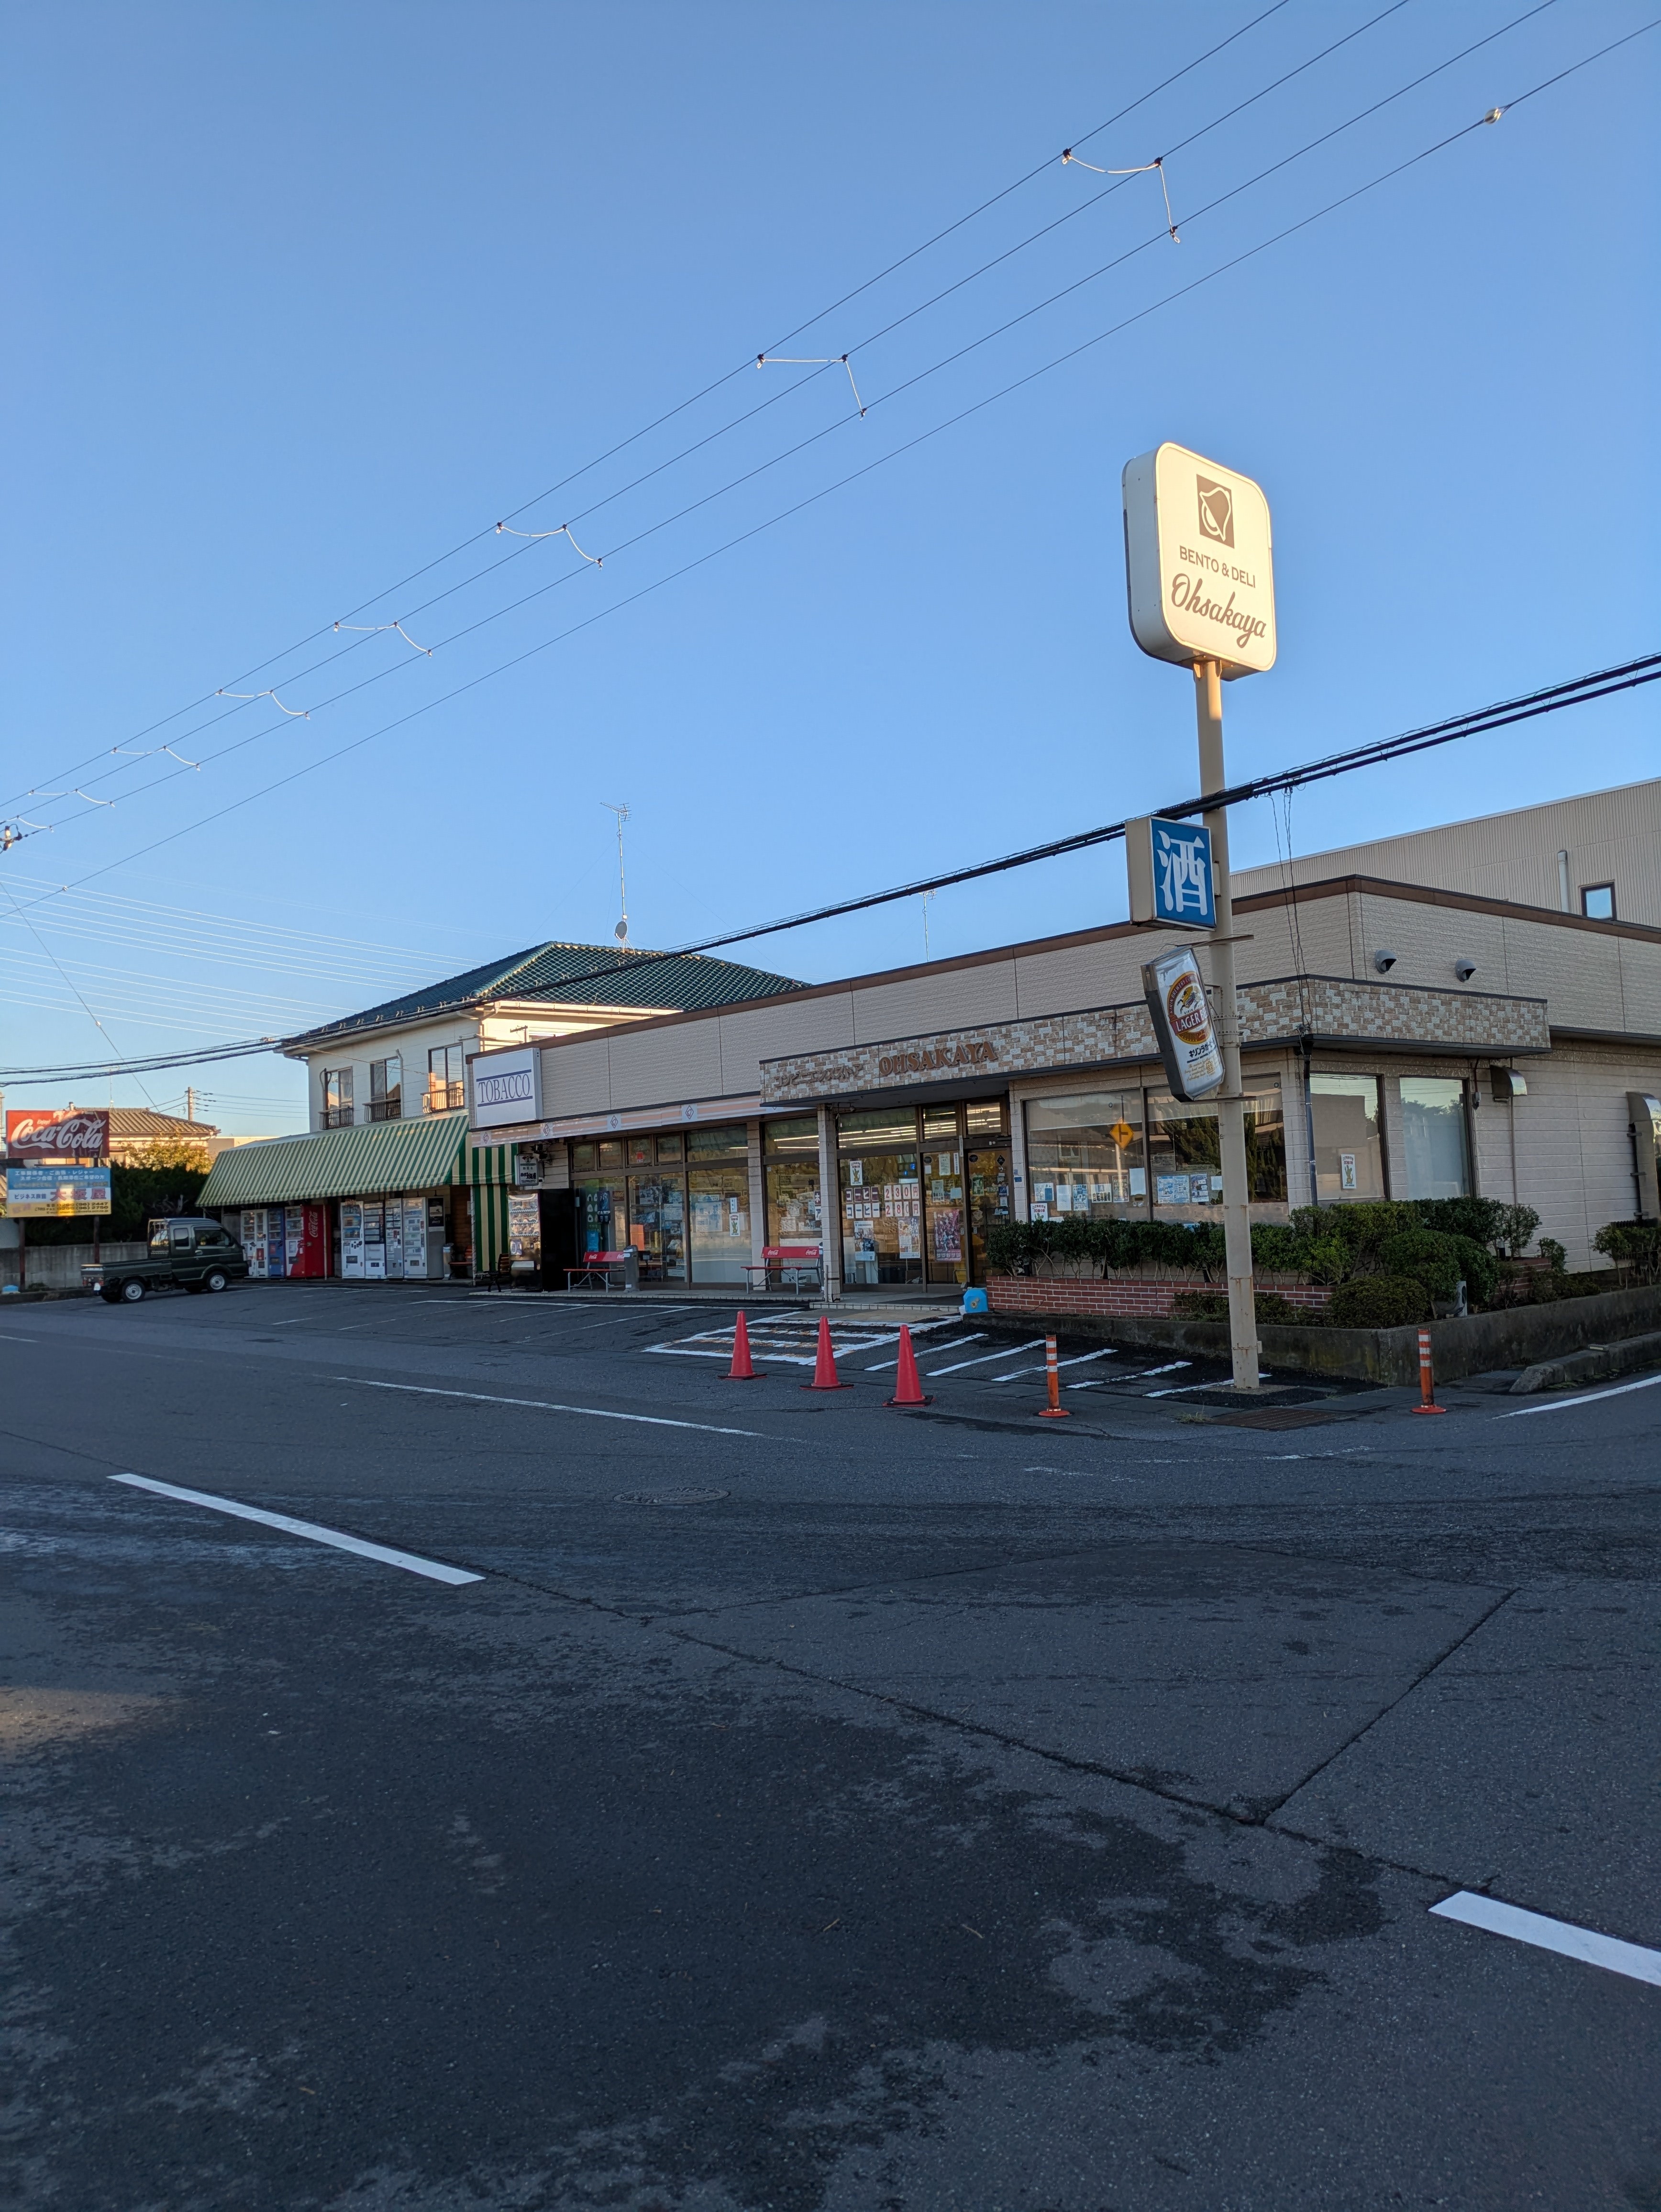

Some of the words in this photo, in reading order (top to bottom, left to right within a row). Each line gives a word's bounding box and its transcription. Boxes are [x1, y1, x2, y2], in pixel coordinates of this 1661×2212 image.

[1179, 545, 1219, 573] BENTO
[1222, 563, 1229, 578] &
[1231, 566, 1256, 588] DELI
[1171, 573, 1267, 648] Ohsakaya
[1157, 830, 1207, 916] 酒
[1175, 1012, 1201, 1032] LAGER
[879, 1041, 997, 1076] OHSAKAYA
[478, 1074, 530, 1103] TOBACCO
[774, 1063, 864, 1087] コンビニエンスストア
[11, 1119, 107, 1149] Coca-Cola
